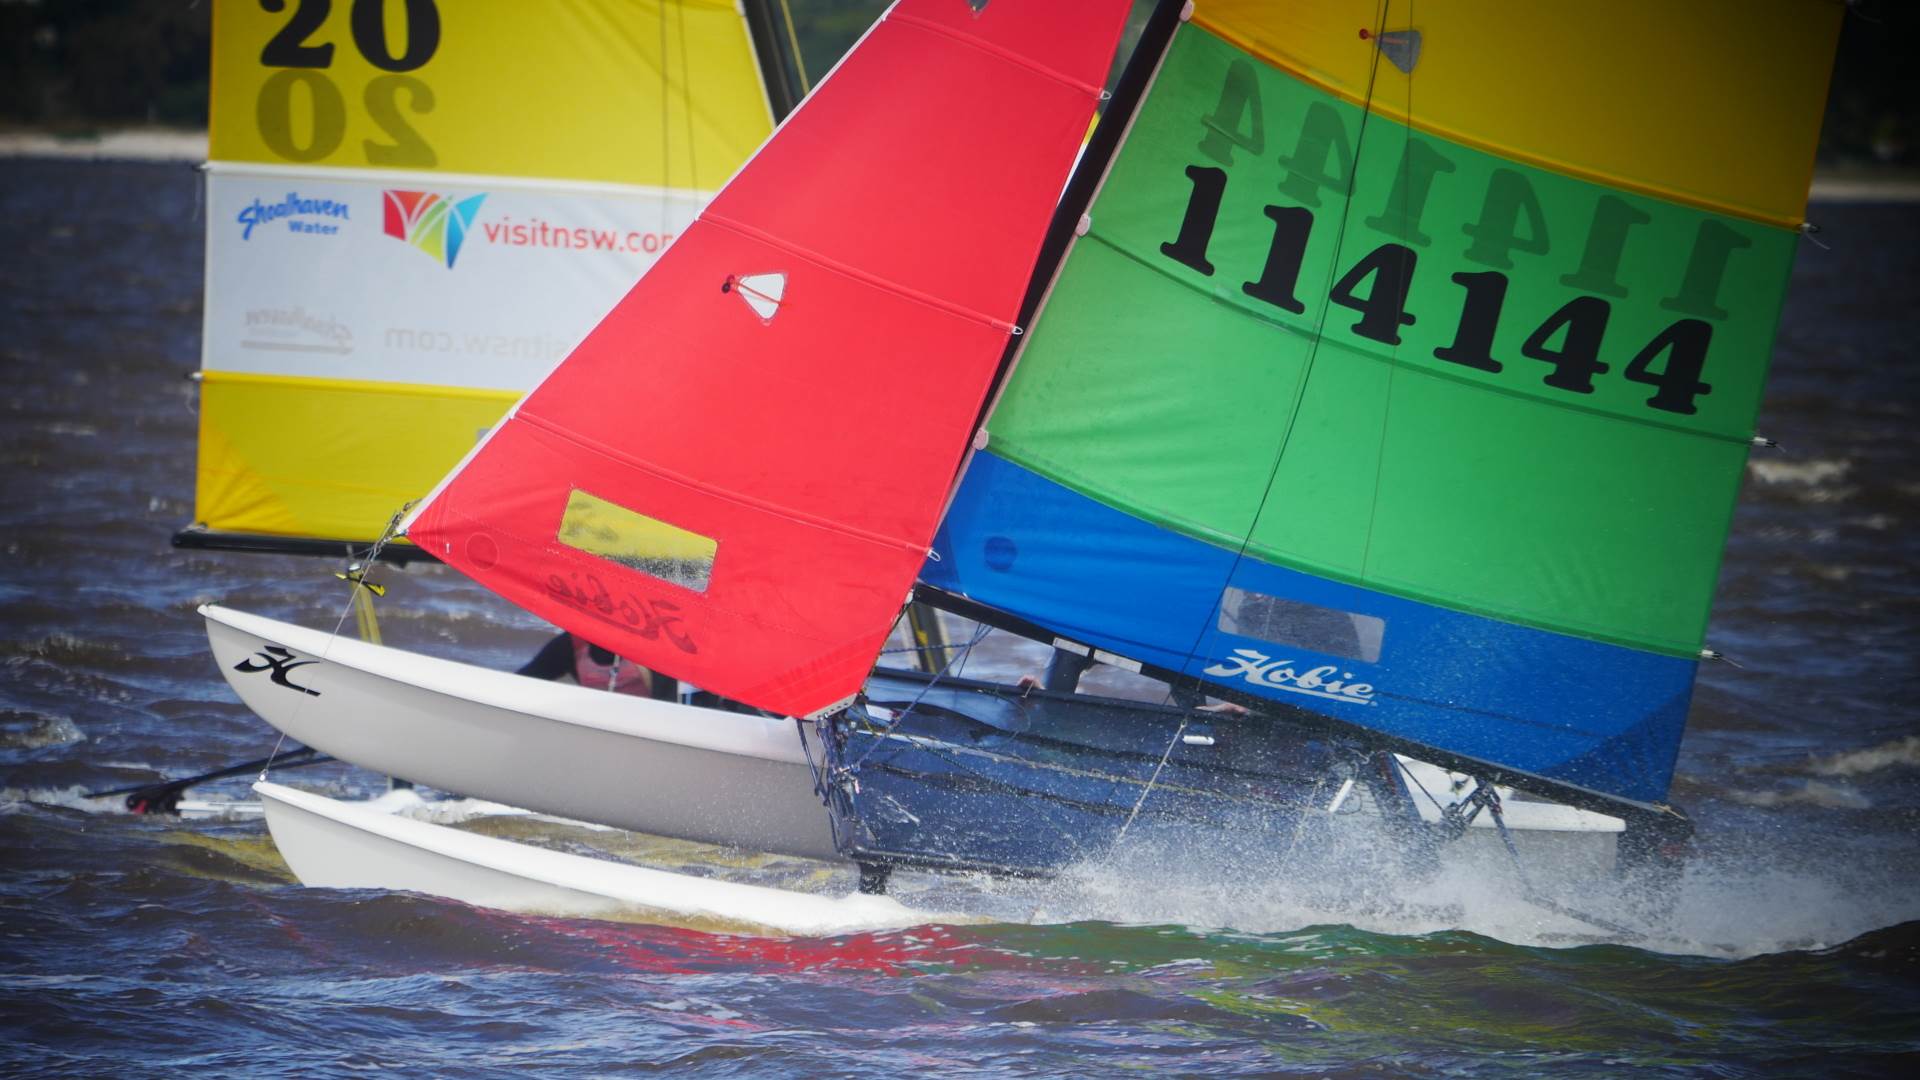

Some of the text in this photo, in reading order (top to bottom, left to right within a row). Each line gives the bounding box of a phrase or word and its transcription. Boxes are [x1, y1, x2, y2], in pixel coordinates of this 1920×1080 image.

[260, 0, 440, 73] 20
[288, 220, 339, 235] Water
[1159, 164, 1713, 415] 114144
[1203, 648, 1375, 705] Hobie
